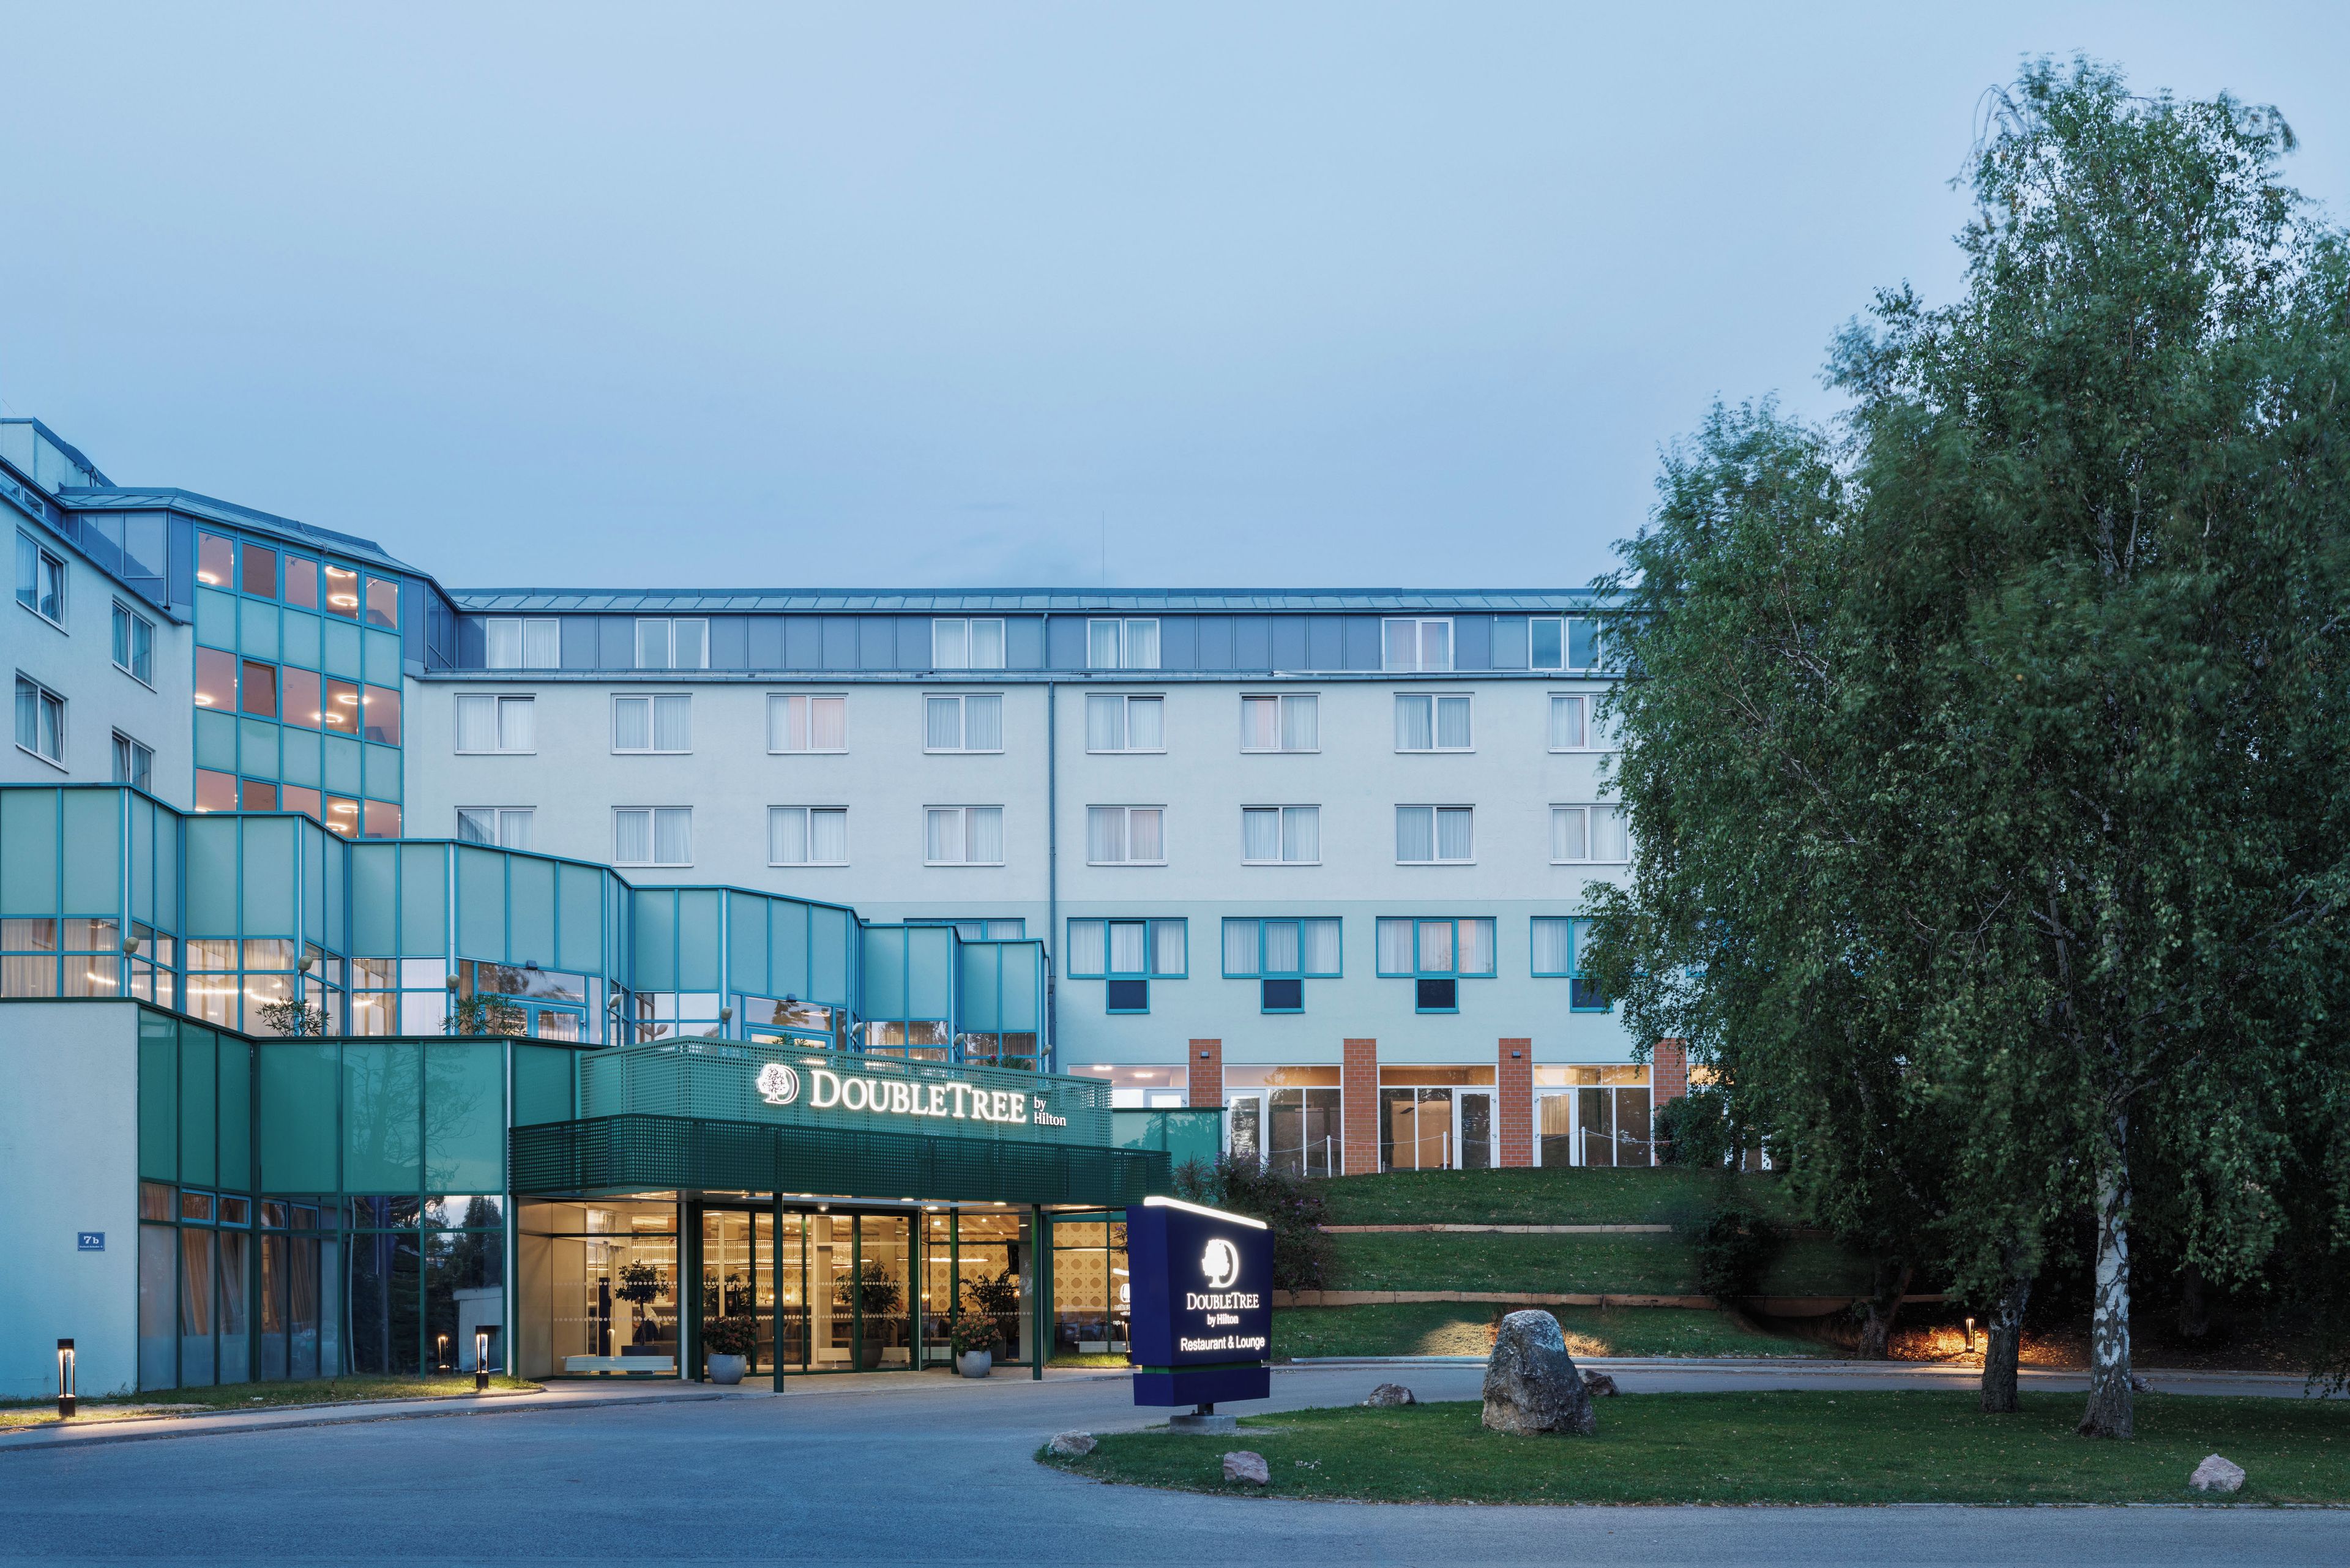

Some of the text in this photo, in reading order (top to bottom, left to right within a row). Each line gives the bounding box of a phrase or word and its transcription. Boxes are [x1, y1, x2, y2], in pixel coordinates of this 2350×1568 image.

[1034, 1096, 1046, 1111] by
[1034, 1111, 1067, 1127] Hilton
[83, 1236, 99, 1244] 7b
[1207, 1313, 1239, 1327] by Hilton
[1181, 1335, 1265, 1351] Restaurant & Lounge
